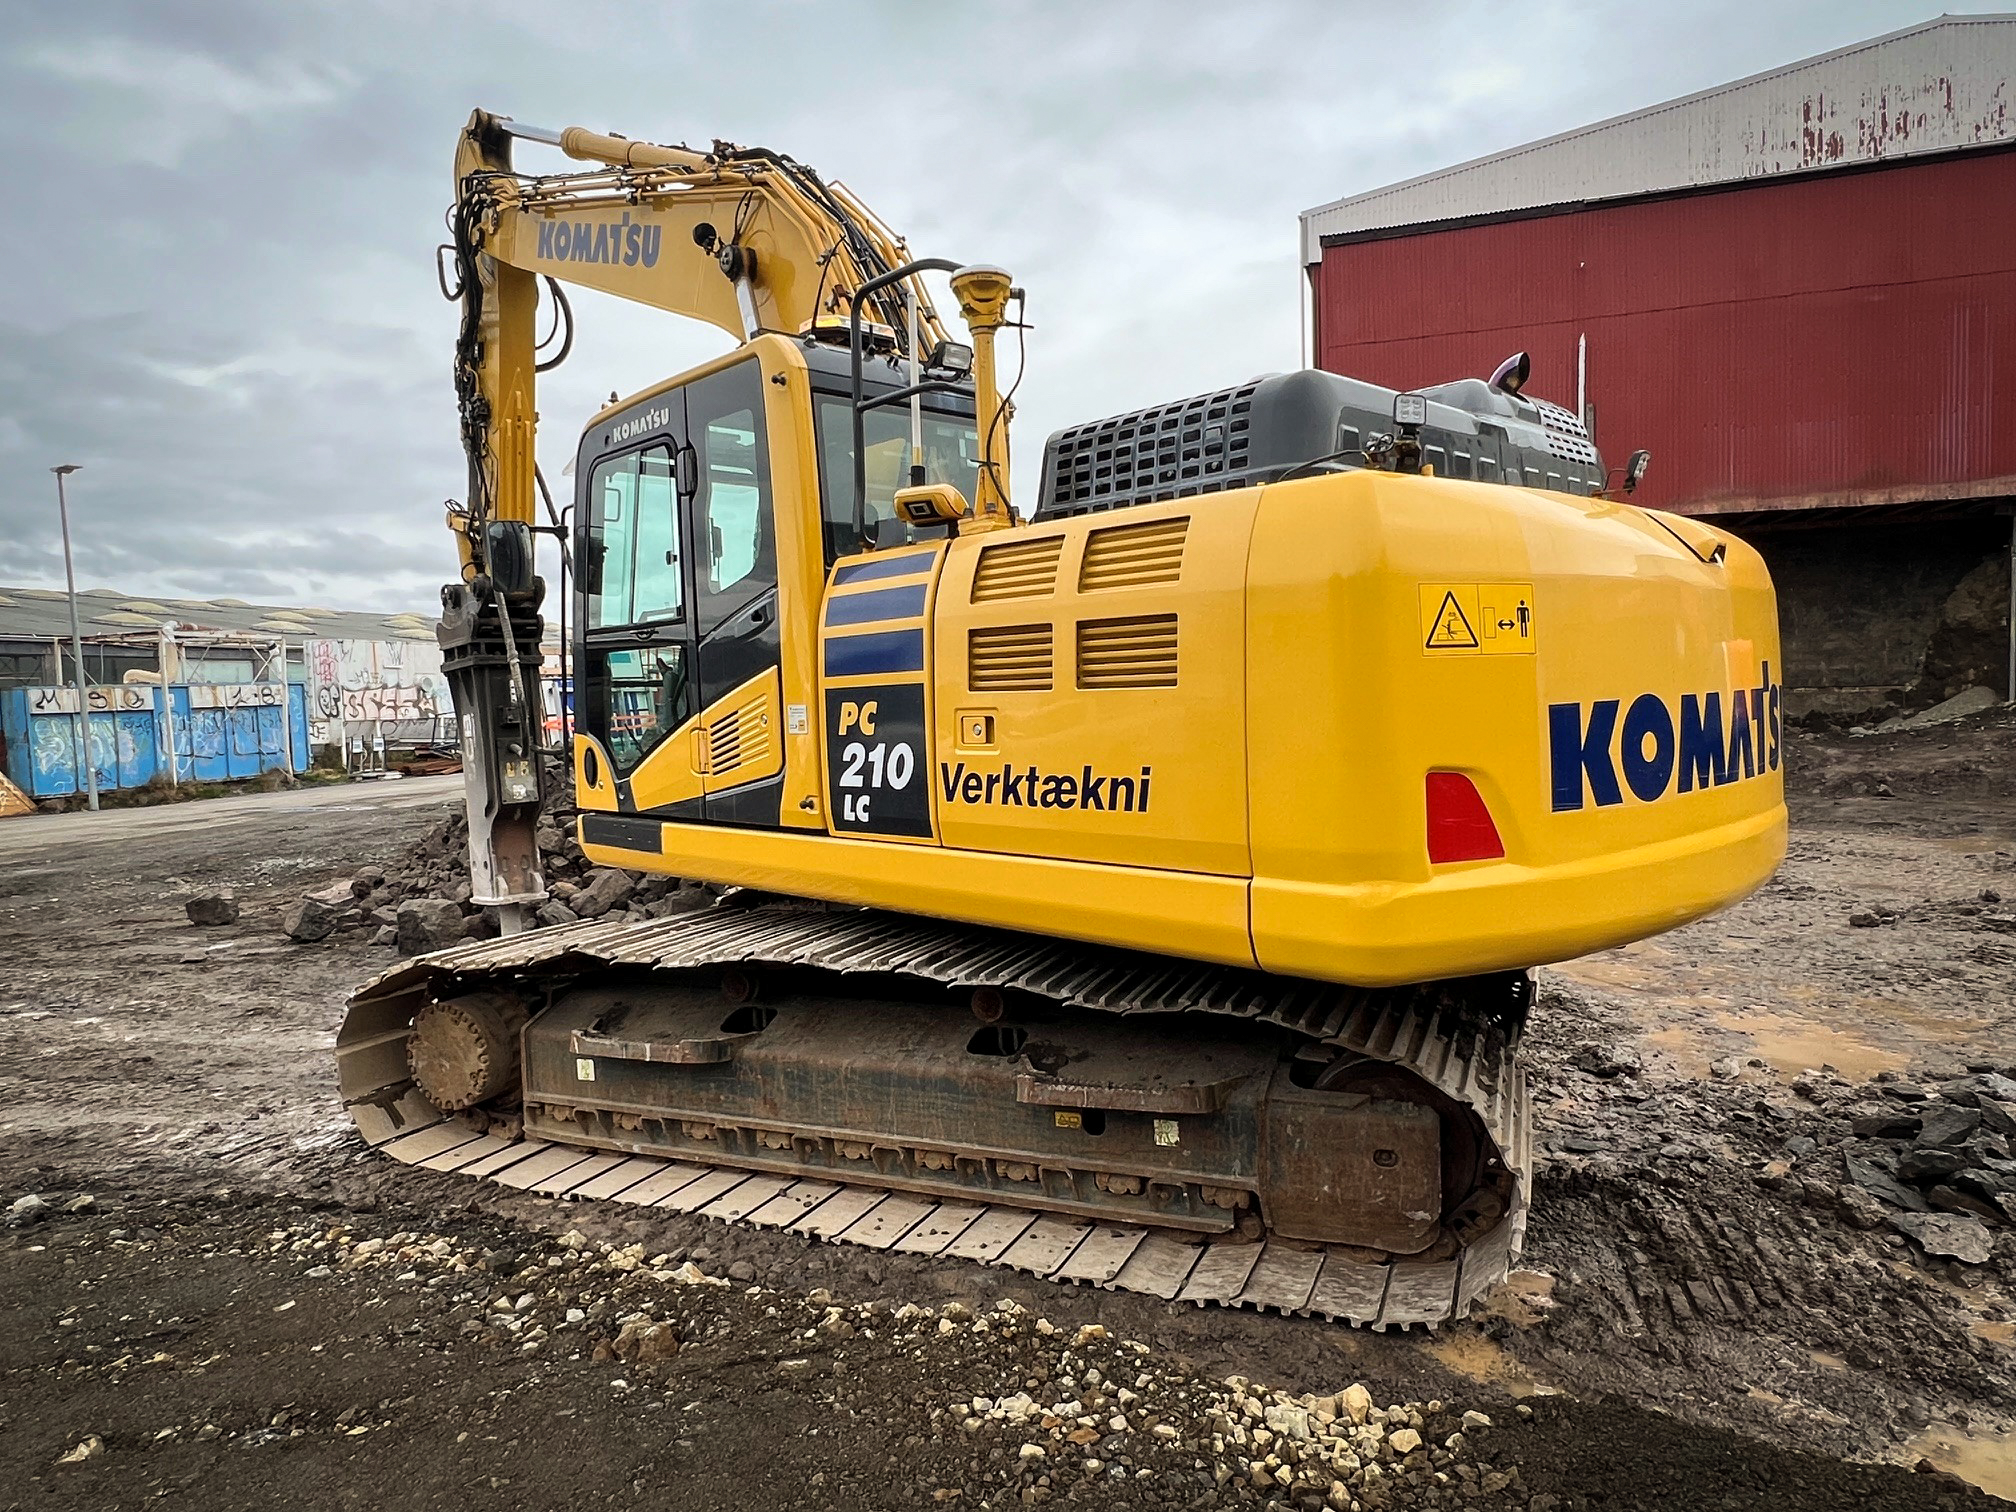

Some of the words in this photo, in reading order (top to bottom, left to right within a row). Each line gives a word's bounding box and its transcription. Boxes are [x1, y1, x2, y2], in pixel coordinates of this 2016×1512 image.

[537, 211, 662, 268] KOMATSU
[613, 408, 670, 443] KOMATSU
[838, 701, 878, 736] PC
[1548, 660, 1783, 813] KOMATS
[839, 742, 915, 790] 210
[940, 762, 1151, 812] Verktækni
[844, 794, 871, 823] LC
